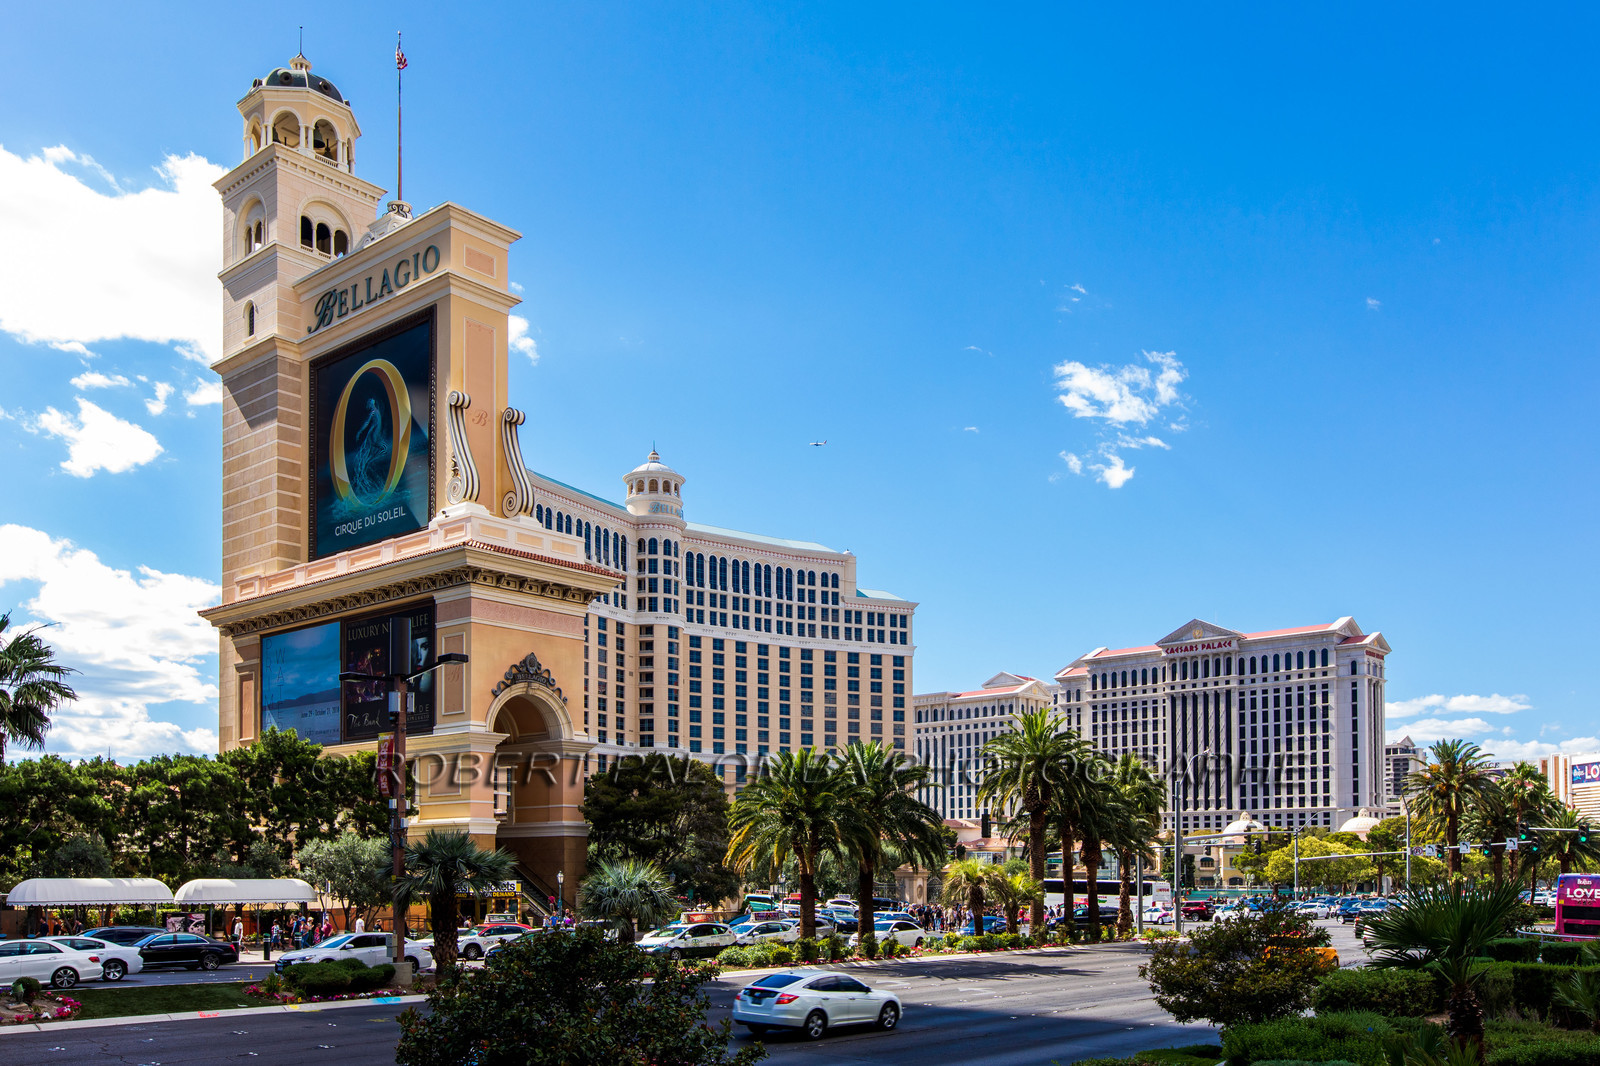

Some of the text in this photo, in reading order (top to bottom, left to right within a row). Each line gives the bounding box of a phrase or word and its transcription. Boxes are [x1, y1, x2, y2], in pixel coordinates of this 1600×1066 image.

[307, 244, 440, 334] BELLAGIO
[334, 505, 406, 537] CIRQUE DU SOLEIL
[348, 623, 380, 641] LUXURY
[1165, 640, 1232, 655] CAESARS PALACE
[347, 708, 382, 729] The Bank
[1585, 764, 1600, 779] LO
[1566, 888, 1600, 899] LOVE
